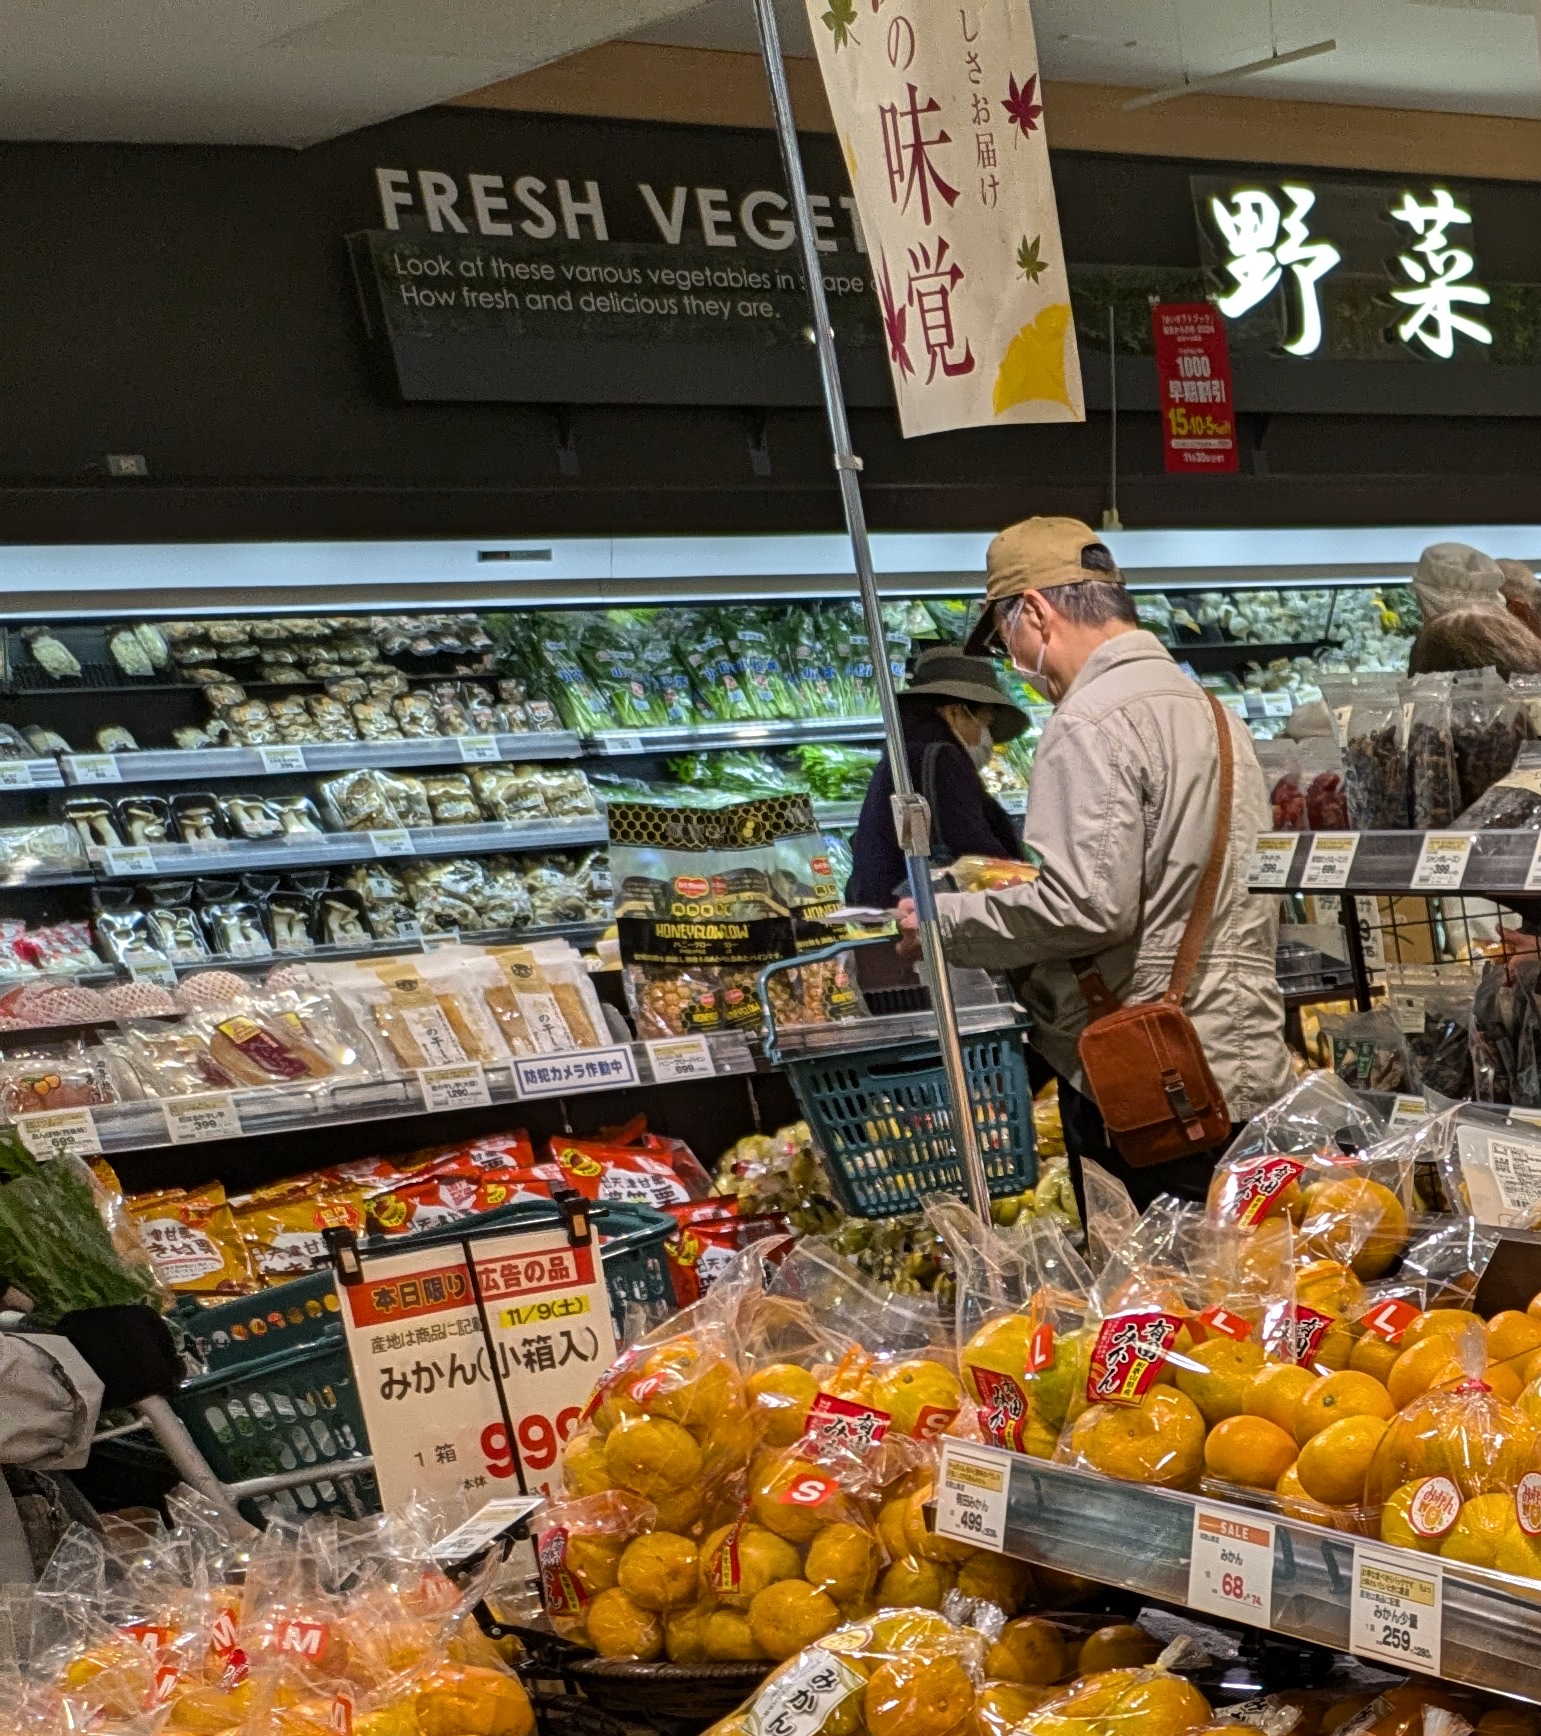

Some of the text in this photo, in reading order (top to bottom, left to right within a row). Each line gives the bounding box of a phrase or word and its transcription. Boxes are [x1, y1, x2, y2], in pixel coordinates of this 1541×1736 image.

[959, 4, 1001, 211] しさお届け
[375, 167, 609, 242] FRESH
[872, 0, 975, 386] の味覚
[395, 254, 795, 292] Look at these various vegetables in
[1209, 183, 1495, 361] 野菜
[401, 283, 782, 320] How fresh and delicious they are.
[522, 1058, 624, 1086] 防犯カメラ作動中
[675, 1064, 695, 1075] 699
[194, 1119, 218, 1131] 399
[51, 1135, 76, 1148] 699
[371, 1254, 571, 1314] 本日限り 広告の品
[507, 1296, 584, 1326] 11/9(土)
[1211, 1311, 1236, 1335] L
[1377, 1303, 1398, 1333] L
[1033, 1335, 1046, 1365] L
[1136, 1317, 1173, 1362] 有田
[379, 1325, 600, 1401] みかん(小箱入)
[1097, 1323, 1139, 1395] みかん
[923, 1411, 950, 1440] S
[434, 1443, 458, 1465] 箱
[791, 1477, 827, 1503] S
[955, 1493, 990, 1513] 有田みかん
[1423, 1483, 1456, 1516] みかん
[960, 1509, 982, 1535] 499
[1220, 1520, 1250, 1541] SALE
[1220, 1547, 1245, 1565] みかん
[1221, 1572, 1244, 1599] 68
[1373, 1603, 1419, 1630] みかん少量
[288, 1625, 322, 1656] M
[1382, 1625, 1411, 1652] 259
